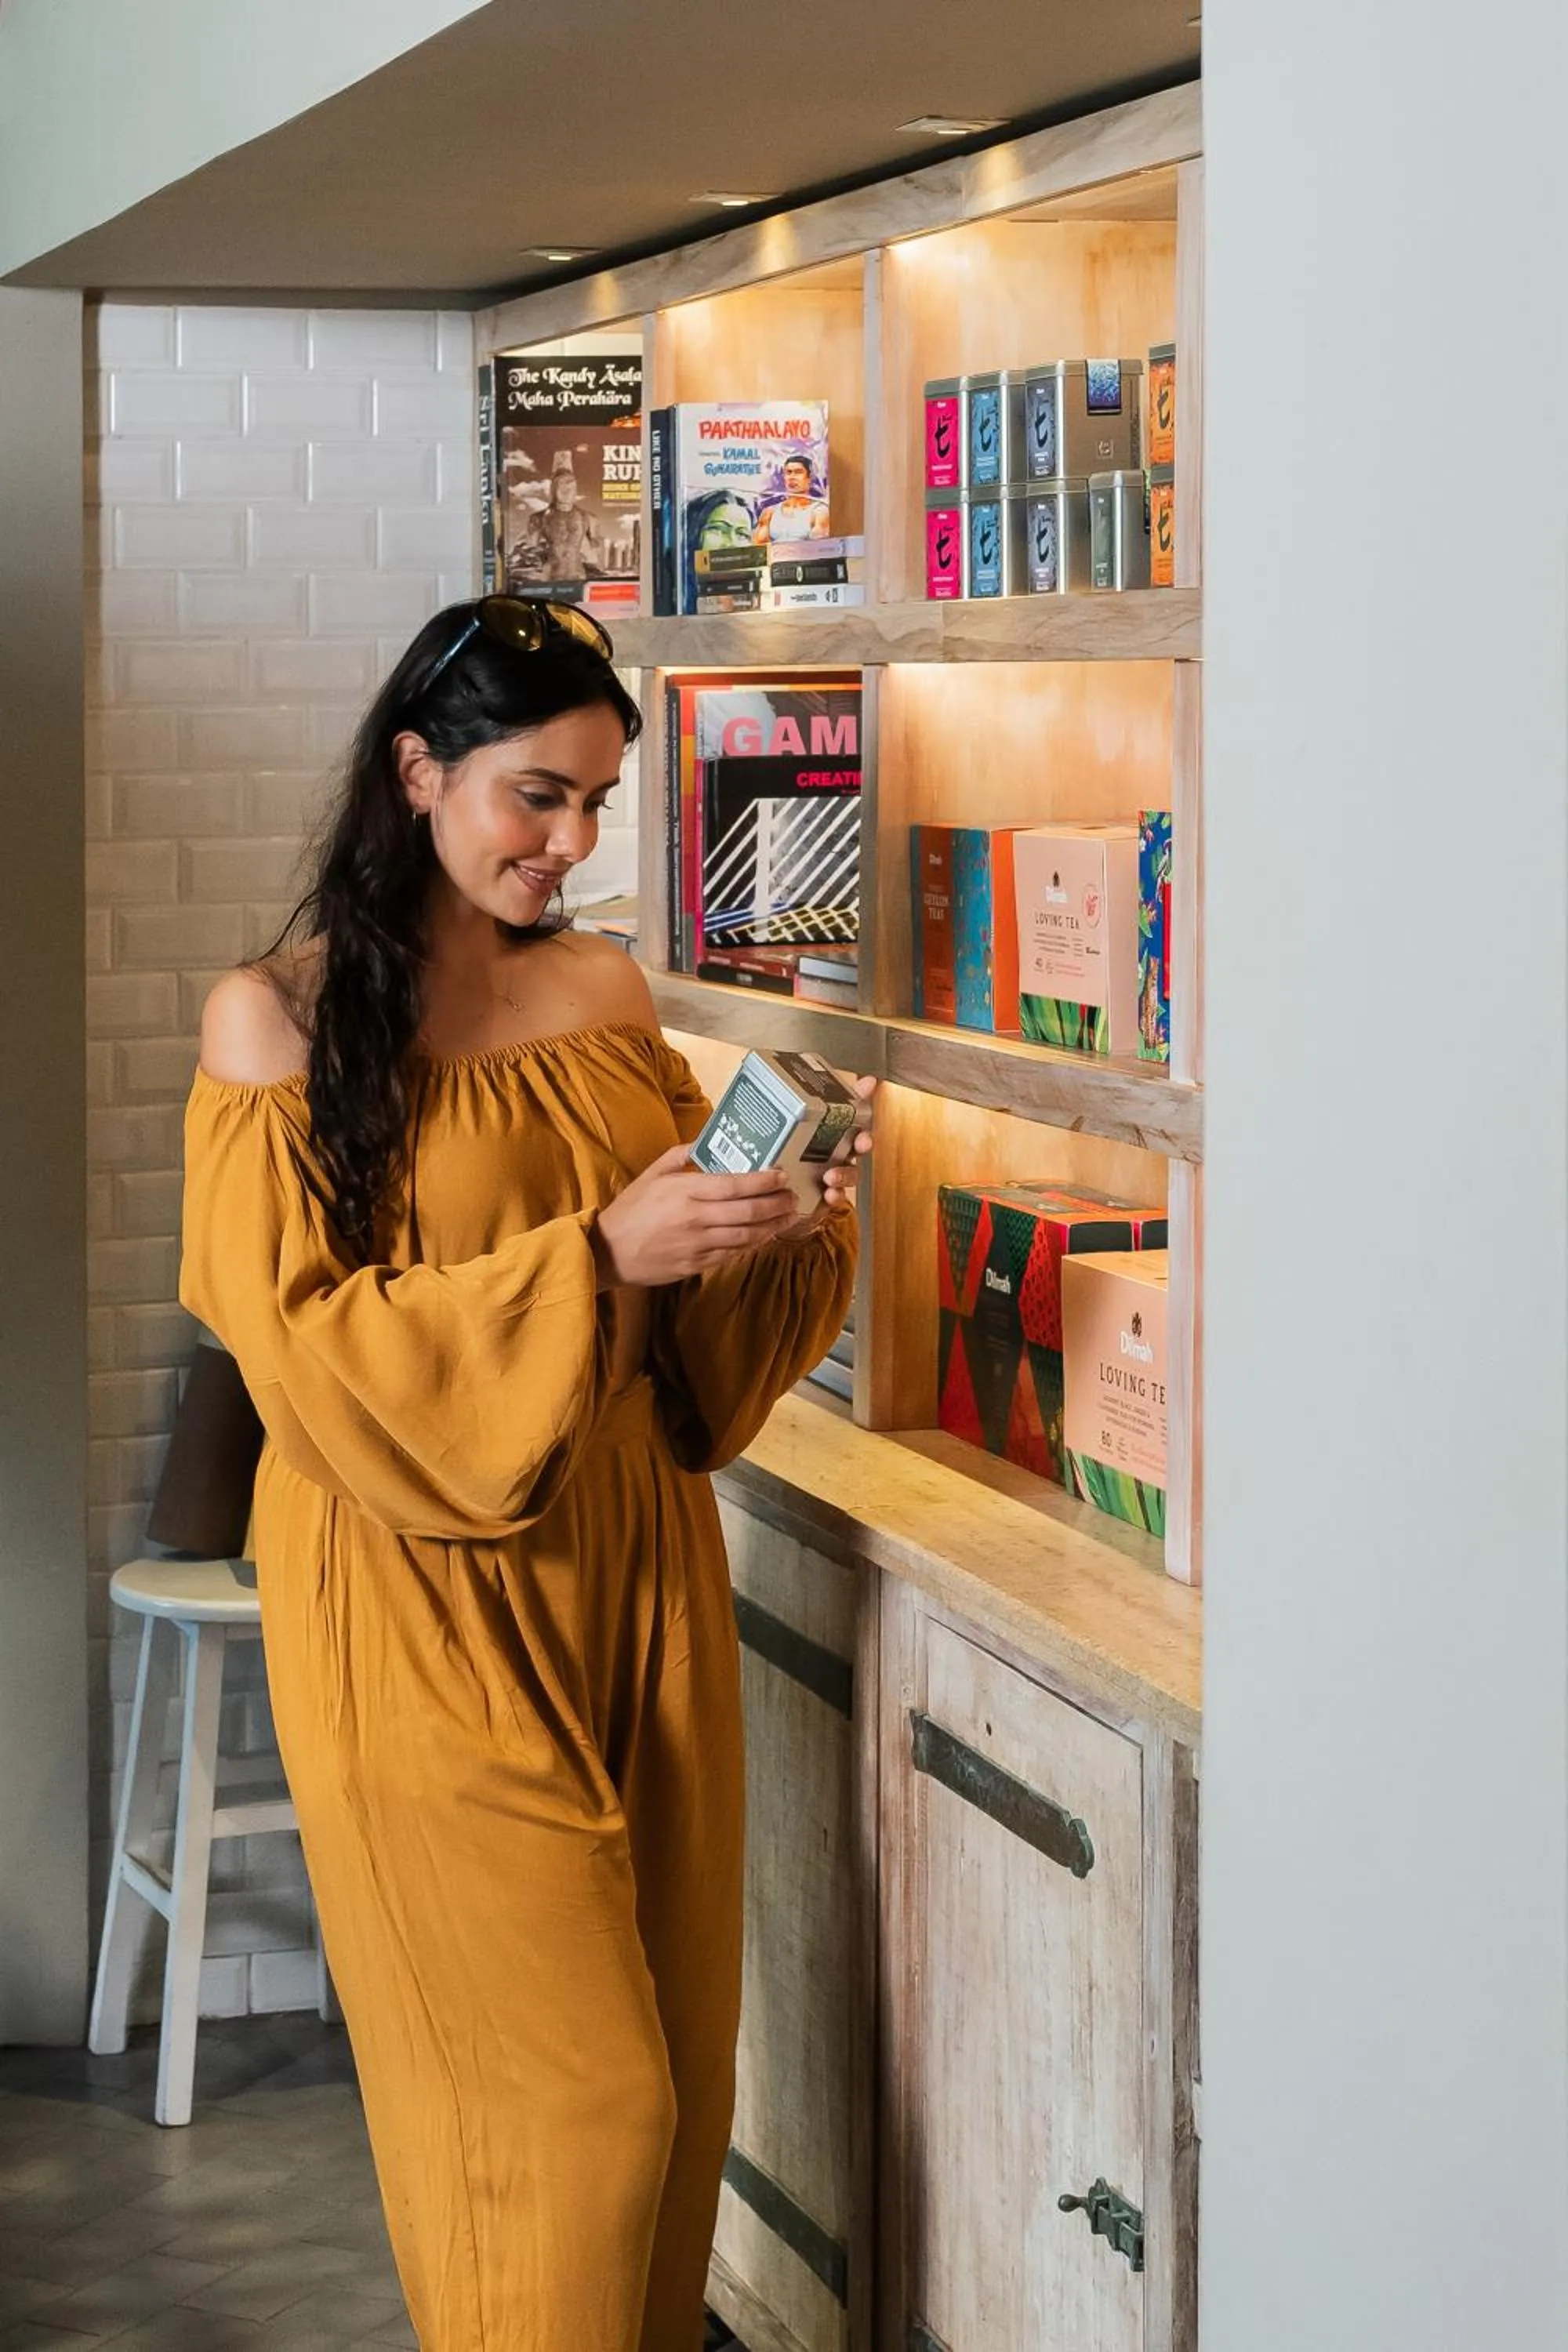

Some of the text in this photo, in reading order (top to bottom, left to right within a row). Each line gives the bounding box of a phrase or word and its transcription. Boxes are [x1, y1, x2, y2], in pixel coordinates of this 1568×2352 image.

[508, 367, 540, 387] The
[542, 367, 597, 389] Kandy
[508, 390, 554, 411] Maha
[480, 443, 492, 524] Lanka
[722, 714, 858, 756] GAM
[1065, 916, 1080, 930] TEA
[1100, 1362, 1145, 1397] LOVING
